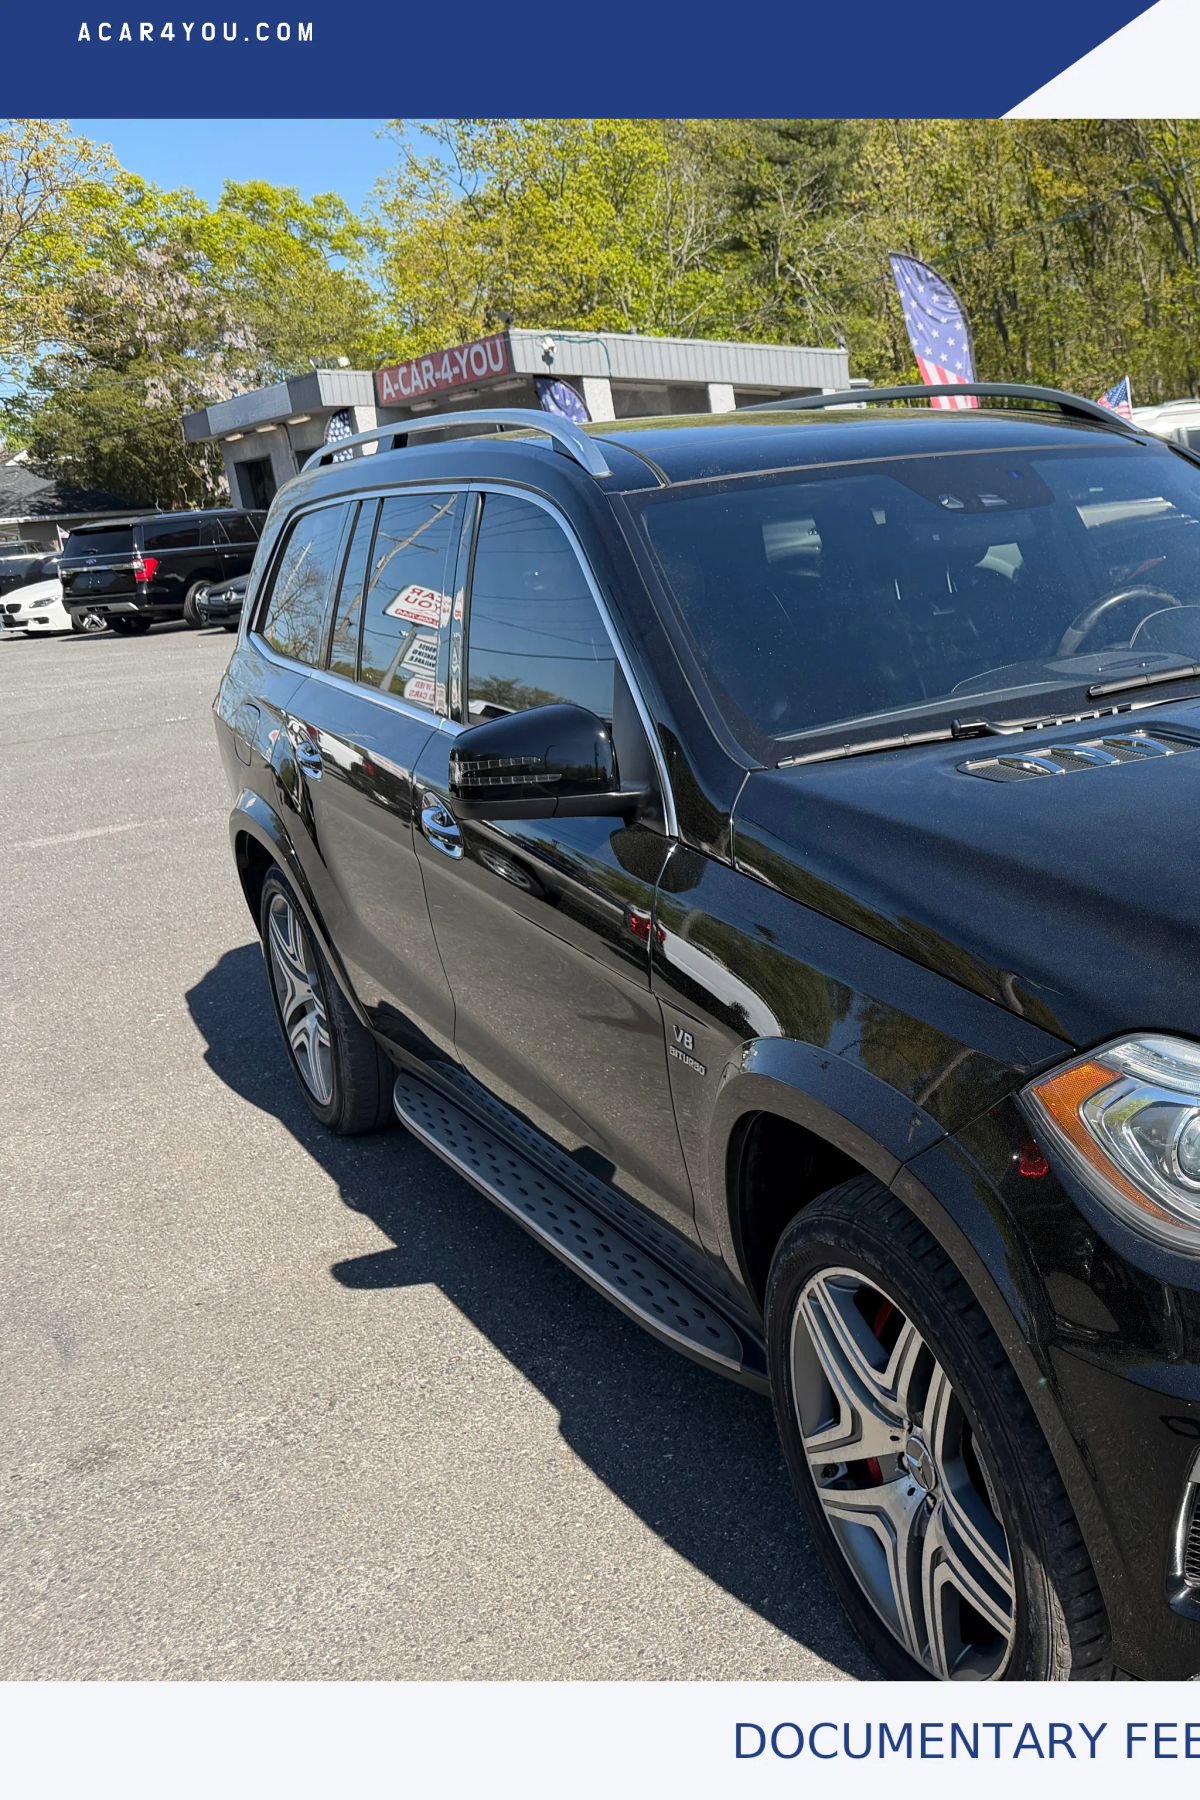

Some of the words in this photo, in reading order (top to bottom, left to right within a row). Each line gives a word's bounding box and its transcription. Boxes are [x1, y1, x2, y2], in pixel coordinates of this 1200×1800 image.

[382, 338, 504, 400] A-CAR-4-YOU
[672, 1024, 694, 1051] V8
[669, 1045, 706, 1076] BITURBO
